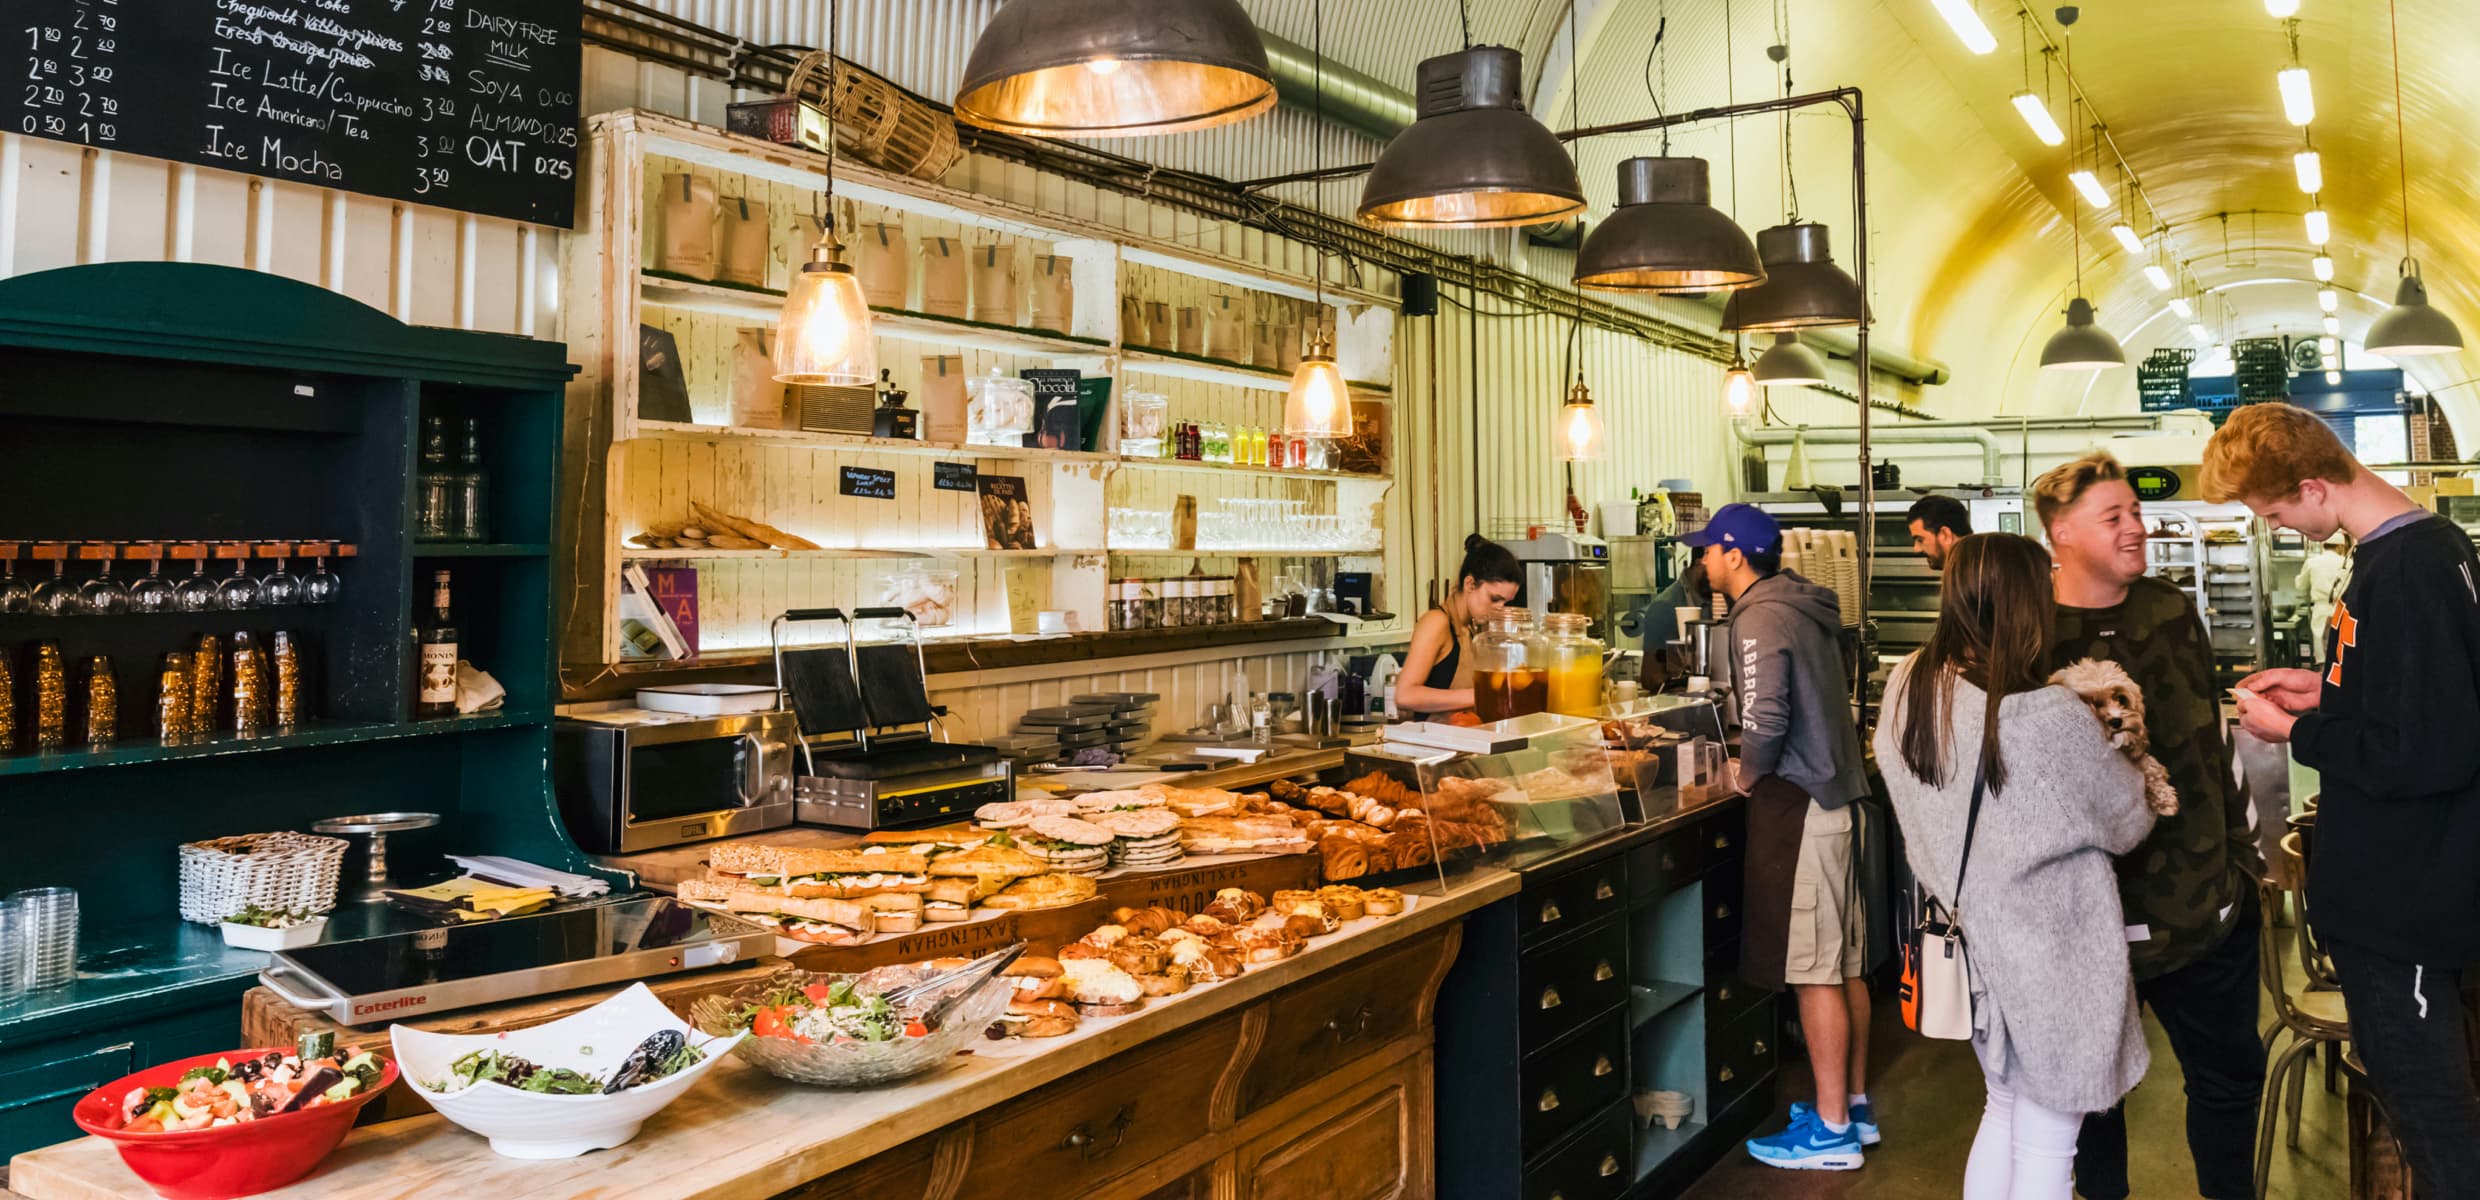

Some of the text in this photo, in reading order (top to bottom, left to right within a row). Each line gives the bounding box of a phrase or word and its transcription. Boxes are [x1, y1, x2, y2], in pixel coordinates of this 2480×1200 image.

[74, 9, 117, 31] 2 70
[421, 18, 434, 35] 2
[438, 22, 451, 33] 00
[465, 9, 558, 46] DAIRY FREE
[25, 27, 116, 59] 1 80 2 20
[490, 40, 528, 60] MILK
[29, 57, 113, 87] 2 60 3 00
[209, 47, 252, 80] Ice
[420, 97, 433, 122] 3
[438, 97, 456, 116] 20
[468, 70, 523, 104] SOYA
[24, 85, 41, 107] 2
[79, 92, 94, 117] 2
[100, 97, 118, 115] 70
[23, 115, 116, 143] 0 50 1 00
[207, 81, 248, 113] Ice
[417, 136, 429, 158] 3
[469, 104, 578, 148] ALMOND 0.25
[206, 124, 449, 194] Ice Mocha 3 50
[466, 136, 573, 180] OAT 0.25
[657, 574, 675, 596] M
[423, 651, 455, 660] MONIN
[1151, 865, 1248, 892] SAXLINGHAM
[899, 917, 1019, 955] SAXLINGHAM
[354, 995, 427, 1016] Caterlite
